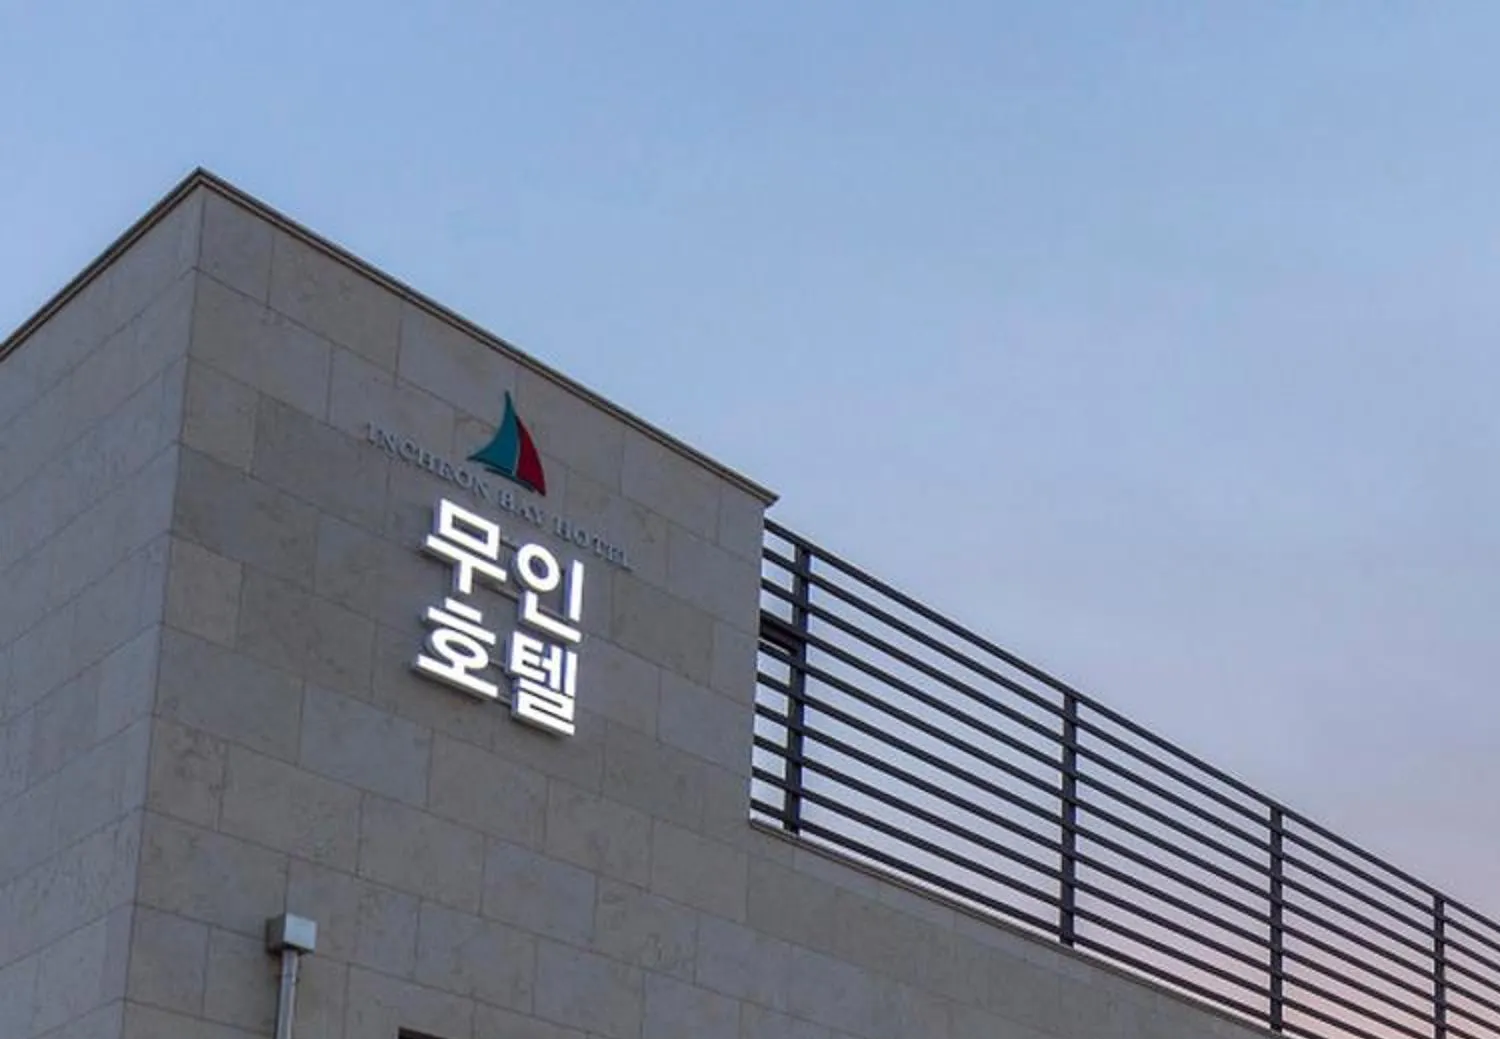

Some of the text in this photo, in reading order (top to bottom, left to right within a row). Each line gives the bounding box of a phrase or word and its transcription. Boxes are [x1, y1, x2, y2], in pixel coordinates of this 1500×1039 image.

[366, 421, 634, 572] INCHEON BAY HOTEL
[424, 498, 584, 643] 무인
[415, 598, 578, 736] 호텔
